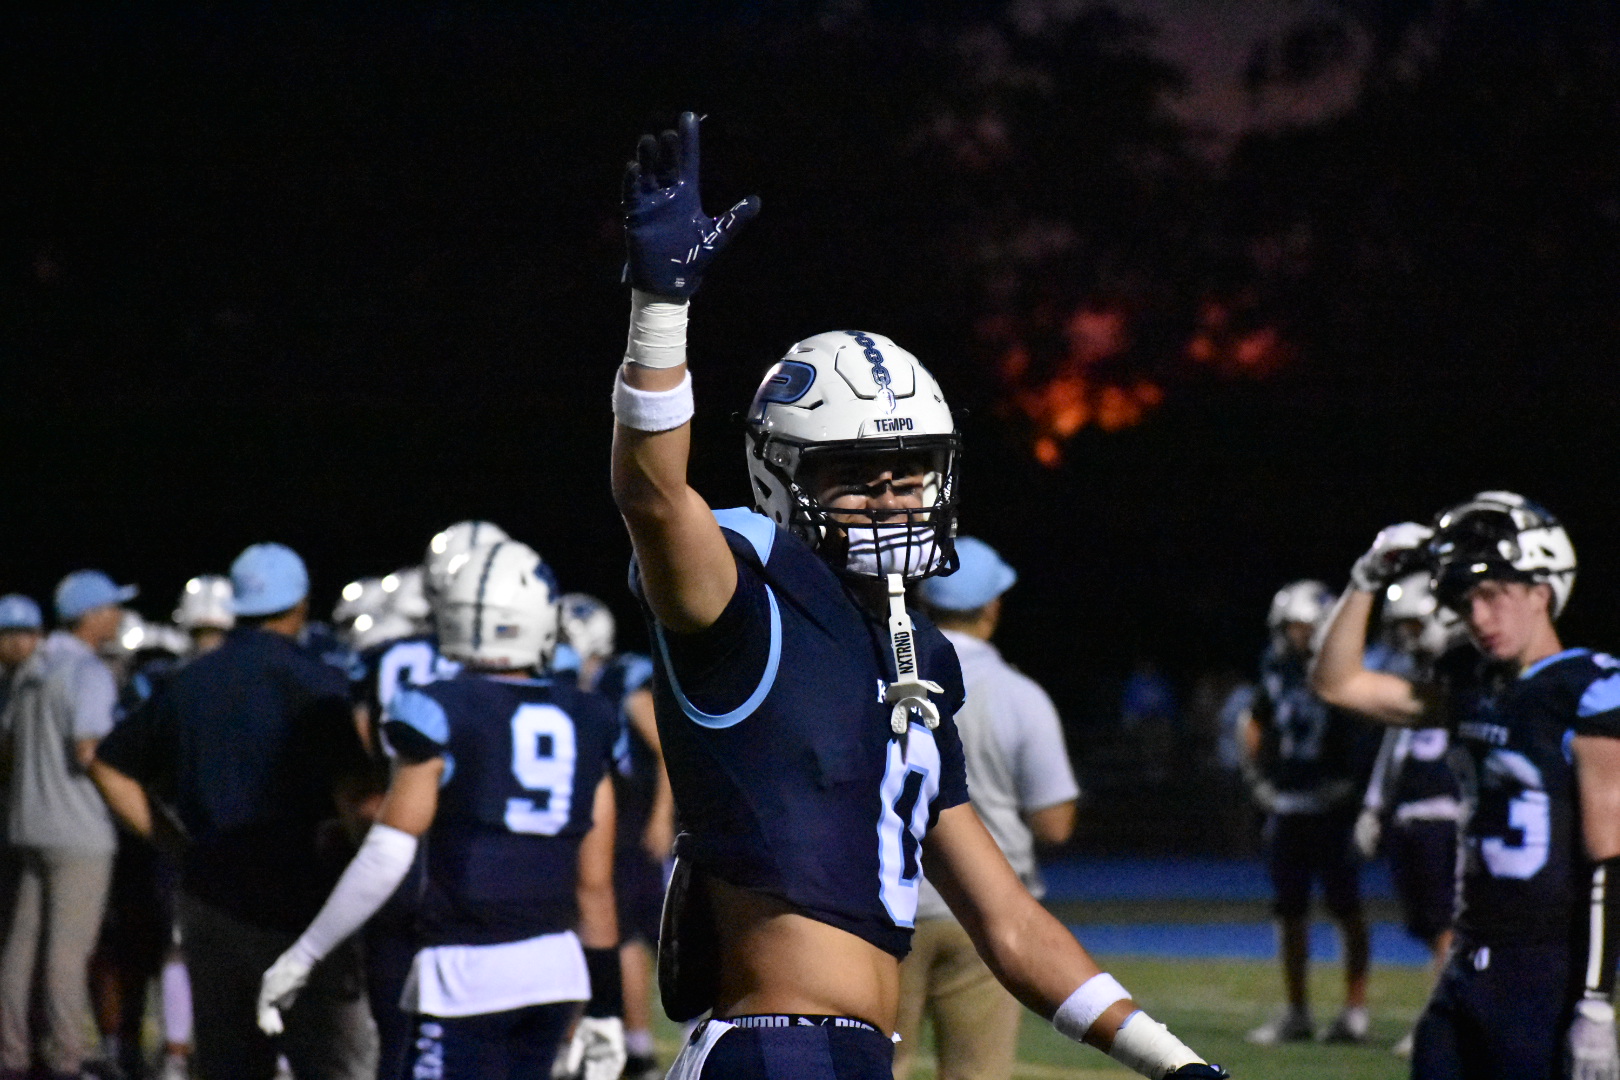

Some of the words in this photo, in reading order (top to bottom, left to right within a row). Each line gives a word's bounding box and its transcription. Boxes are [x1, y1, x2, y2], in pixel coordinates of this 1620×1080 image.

[873, 417, 914, 432] TEMPO
[893, 631, 914, 675] NXTRND
[503, 702, 578, 837] 9
[877, 722, 941, 928] 0
